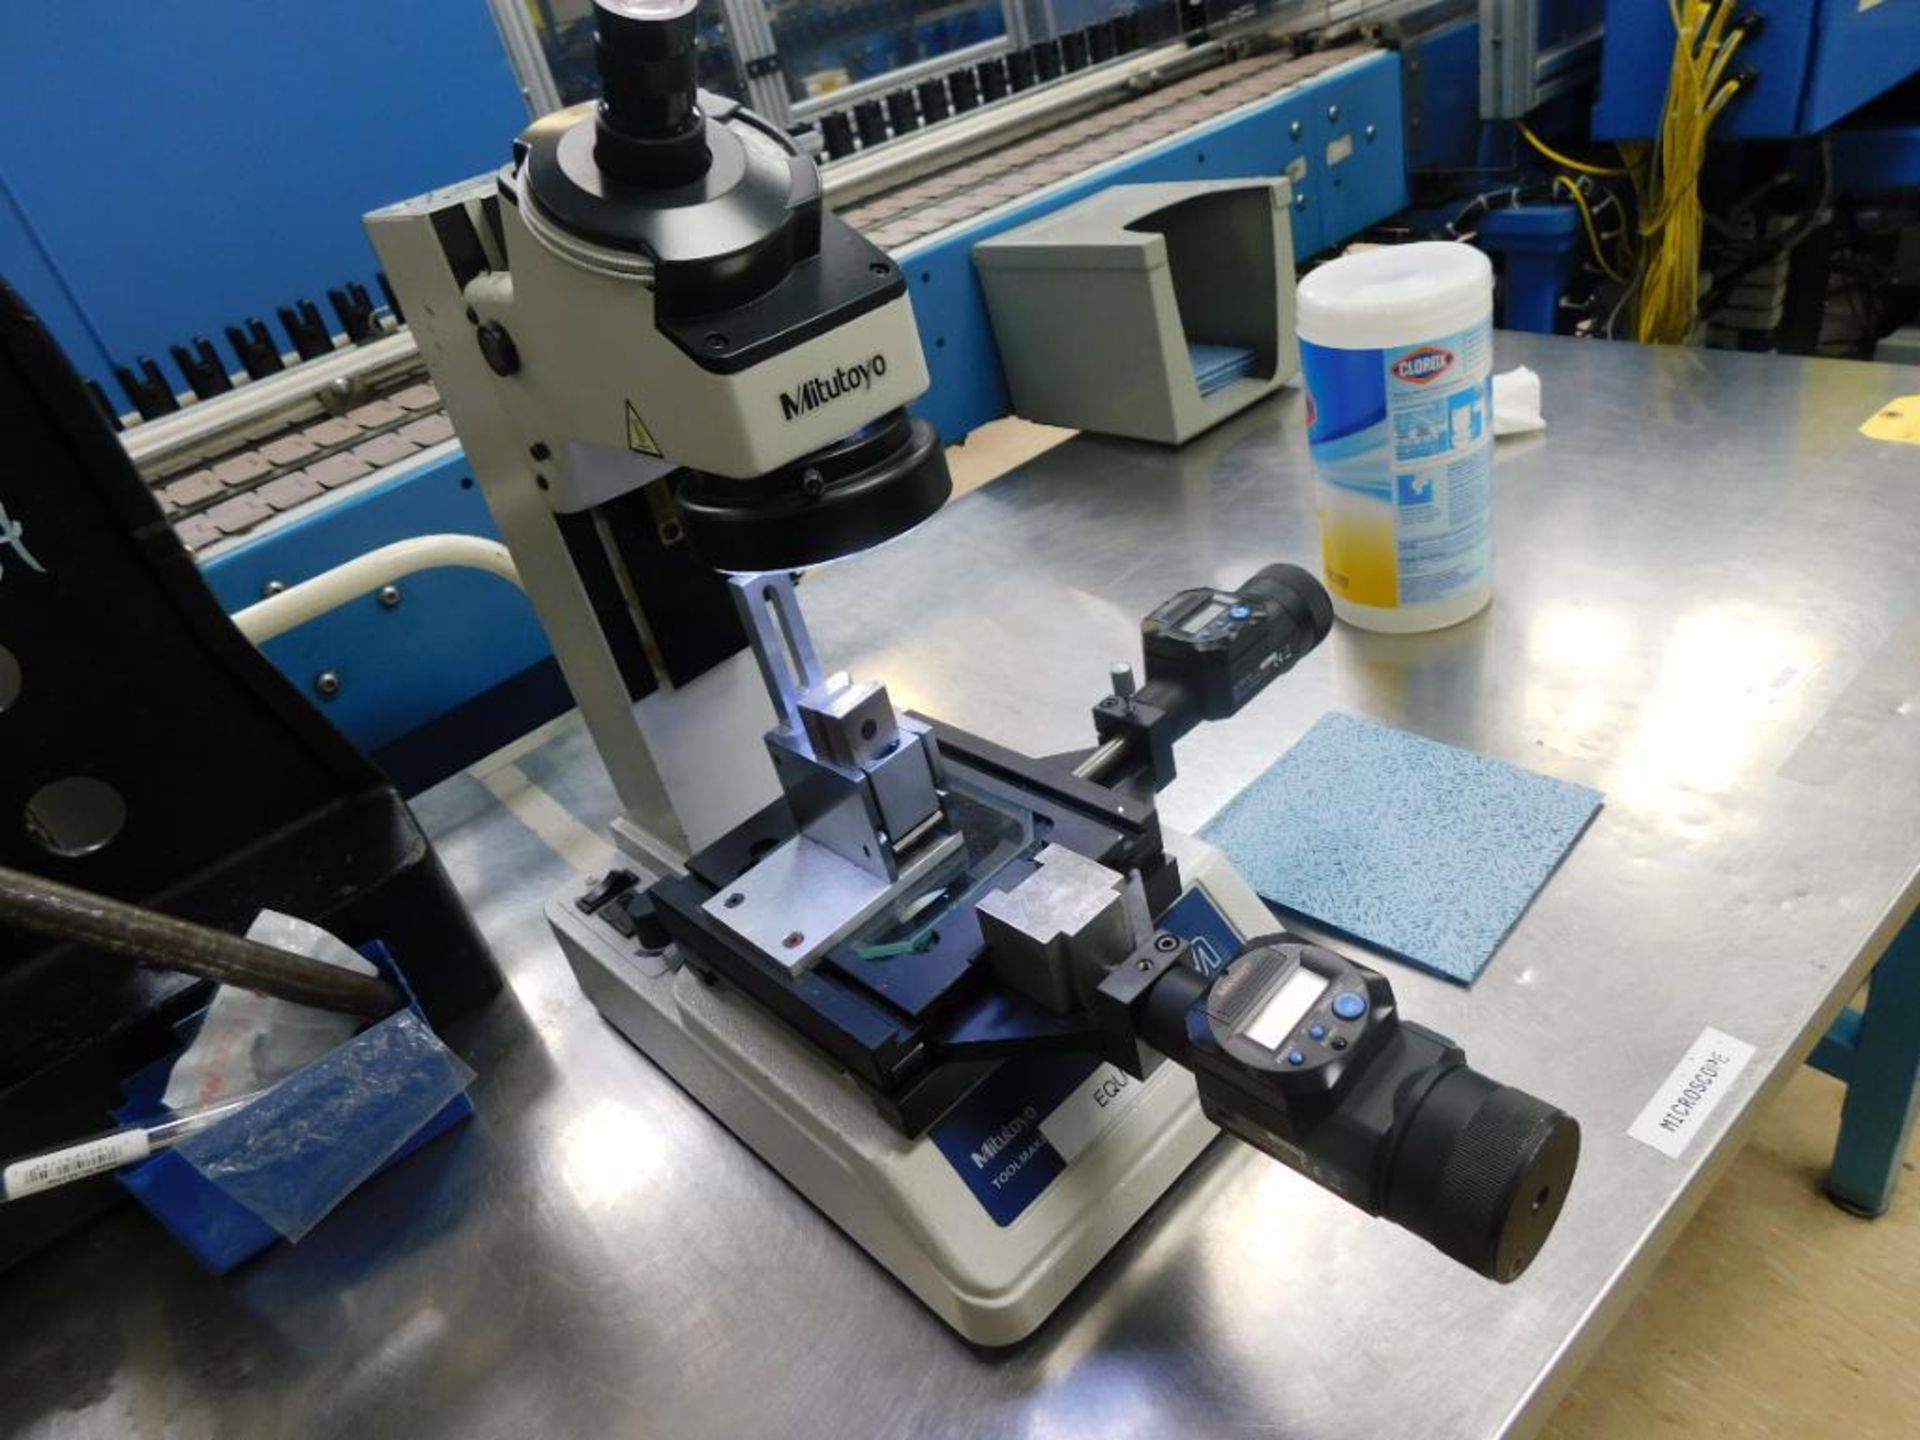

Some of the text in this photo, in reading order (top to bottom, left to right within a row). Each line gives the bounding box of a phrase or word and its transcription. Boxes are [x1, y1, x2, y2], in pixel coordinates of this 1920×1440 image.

[779, 354, 886, 420] Mitutoyo
[1658, 1051, 1730, 1133] MICROSCOPE
[970, 1105, 1038, 1169] Mitutoyo
